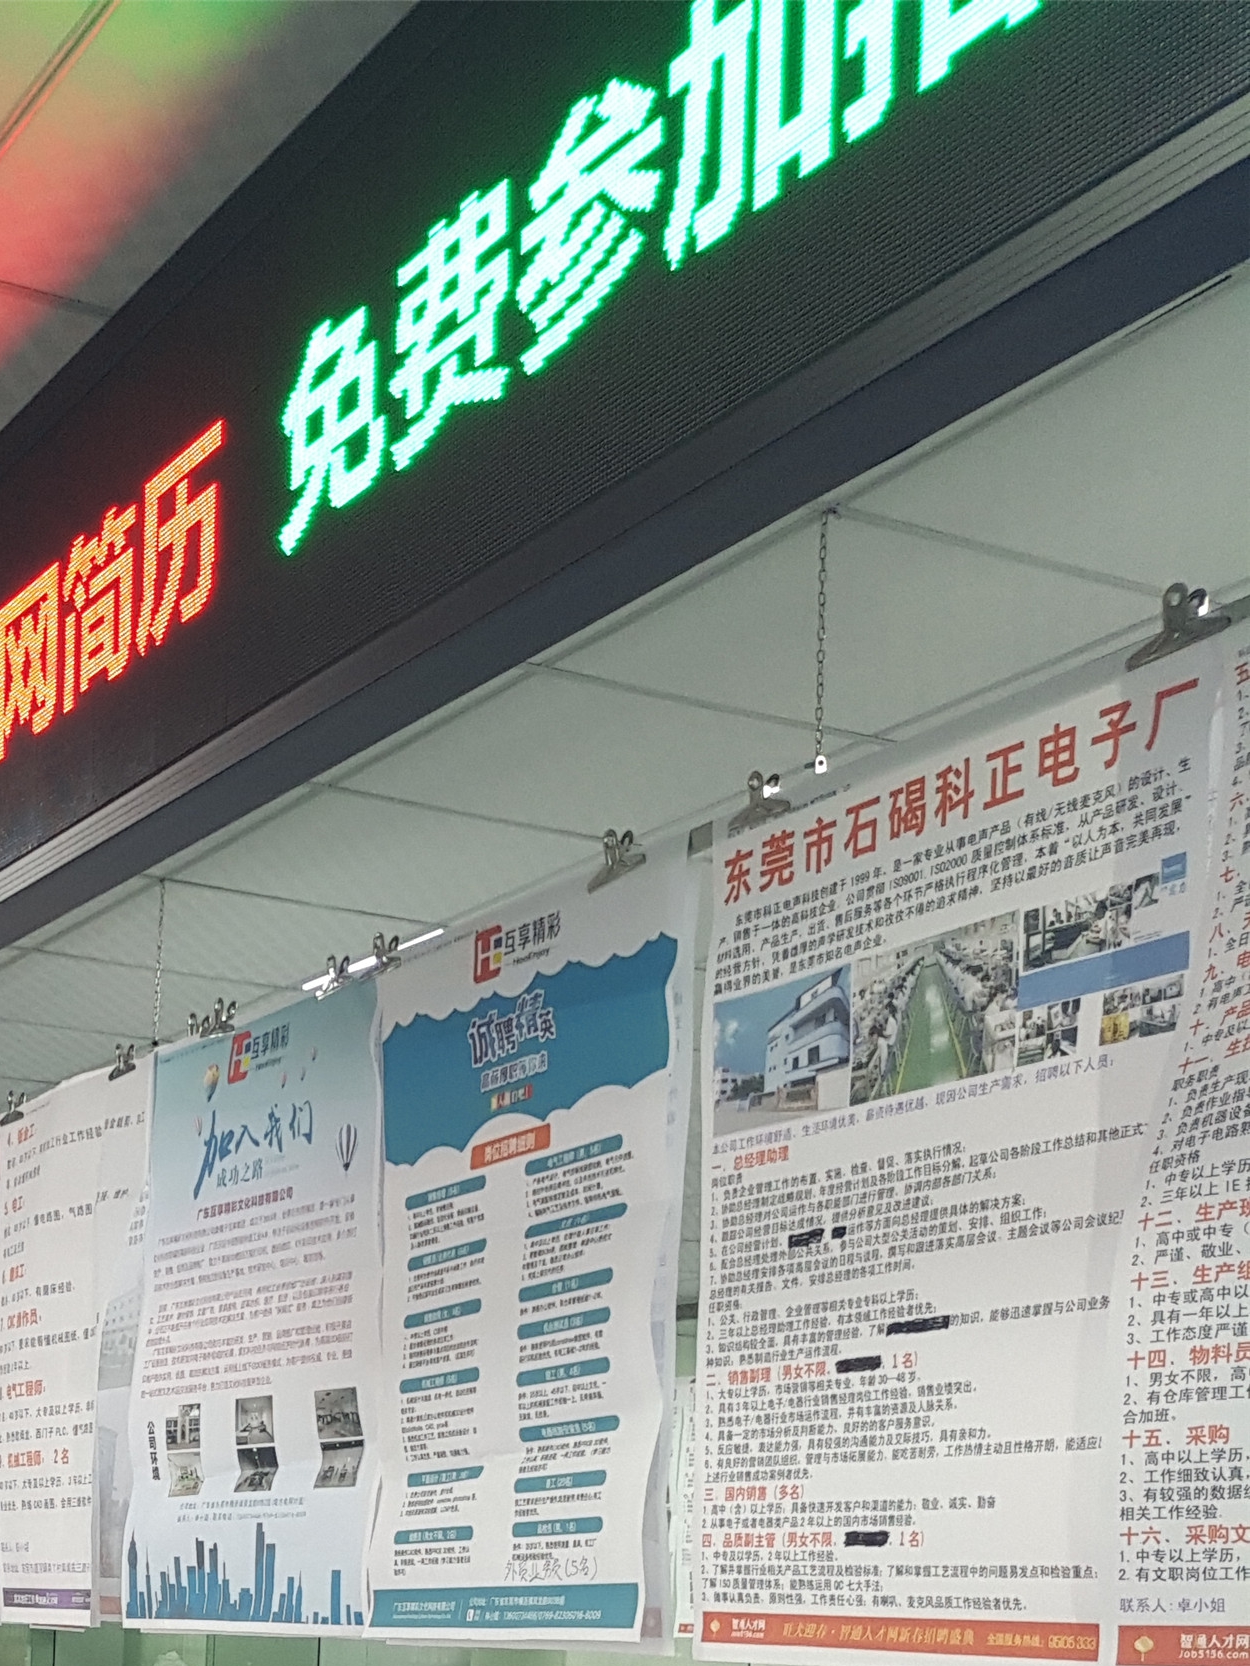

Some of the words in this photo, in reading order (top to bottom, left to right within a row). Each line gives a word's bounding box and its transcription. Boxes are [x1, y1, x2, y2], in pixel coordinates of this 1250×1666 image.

[724, 677, 1200, 906] 东莞市石碣科正电子厂
[504, 910, 562, 956] 互享精彩
[468, 989, 556, 1068] 诚聘精英
[193, 1100, 313, 1201] 加入我们
[711, 1145, 790, 1172] 一、总经理助理
[1150, 1150, 1201, 1174] 任职资格
[216, 1158, 263, 1189] 成功之路
[1126, 1321, 1249, 1345] 3、工作态度严谨
[1125, 1365, 1250, 1388] 1、男女不限，高
[1122, 1424, 1230, 1448] 十五、采购
[1179, 1632, 1250, 1650] 智通人才网
